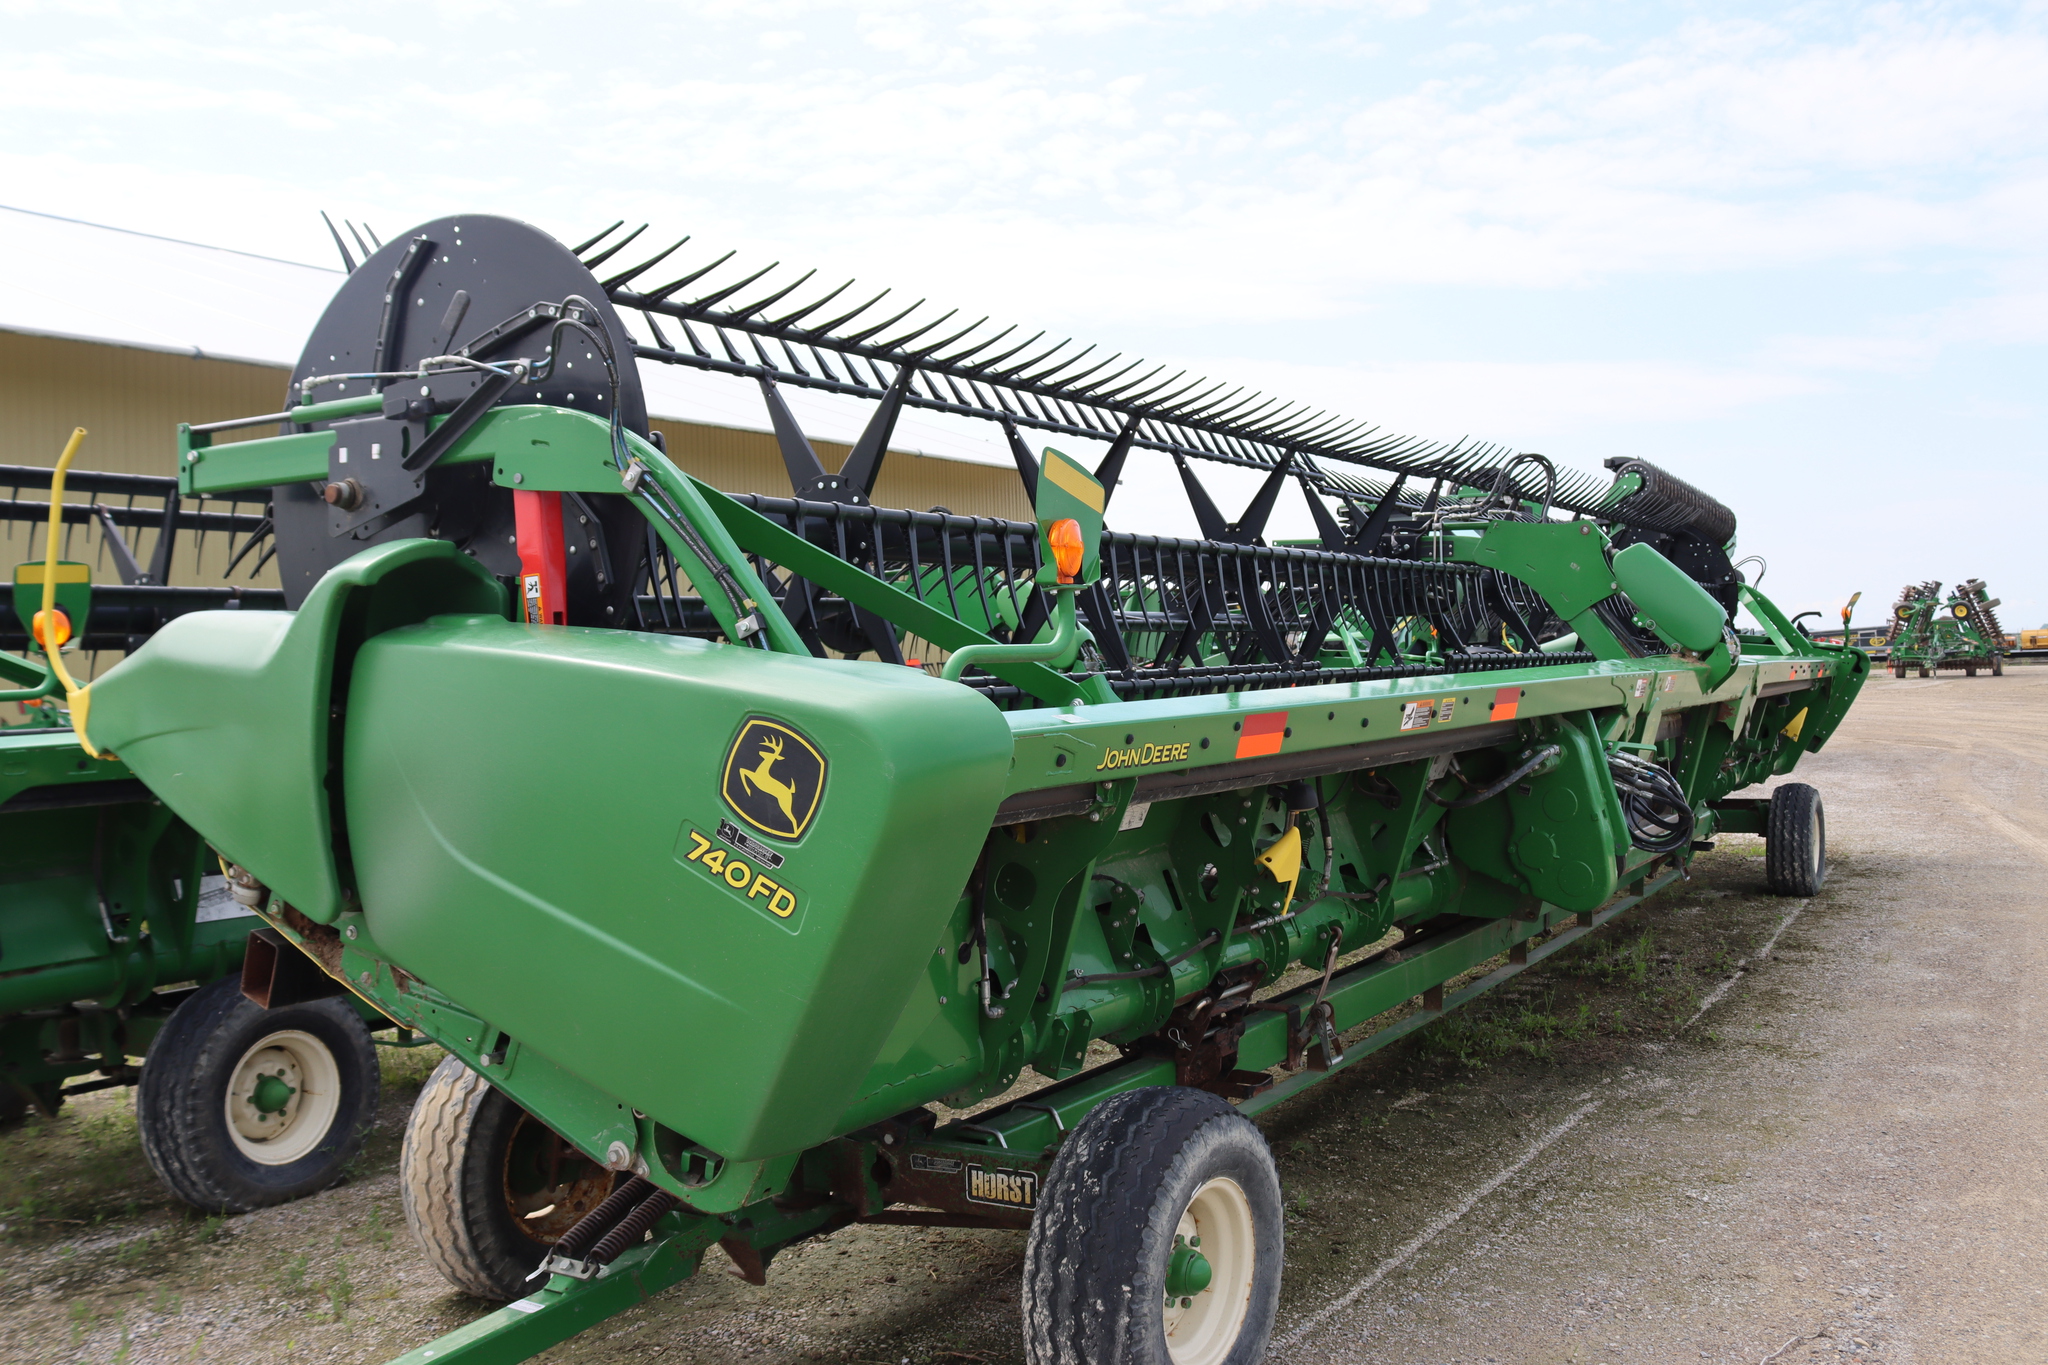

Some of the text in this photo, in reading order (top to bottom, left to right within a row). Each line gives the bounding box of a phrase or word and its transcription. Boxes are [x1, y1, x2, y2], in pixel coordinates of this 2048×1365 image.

[1096, 742, 1190, 771] JOHN DEERE
[686, 829, 797, 919] 740FD
[971, 1169, 1034, 1204] HORST
